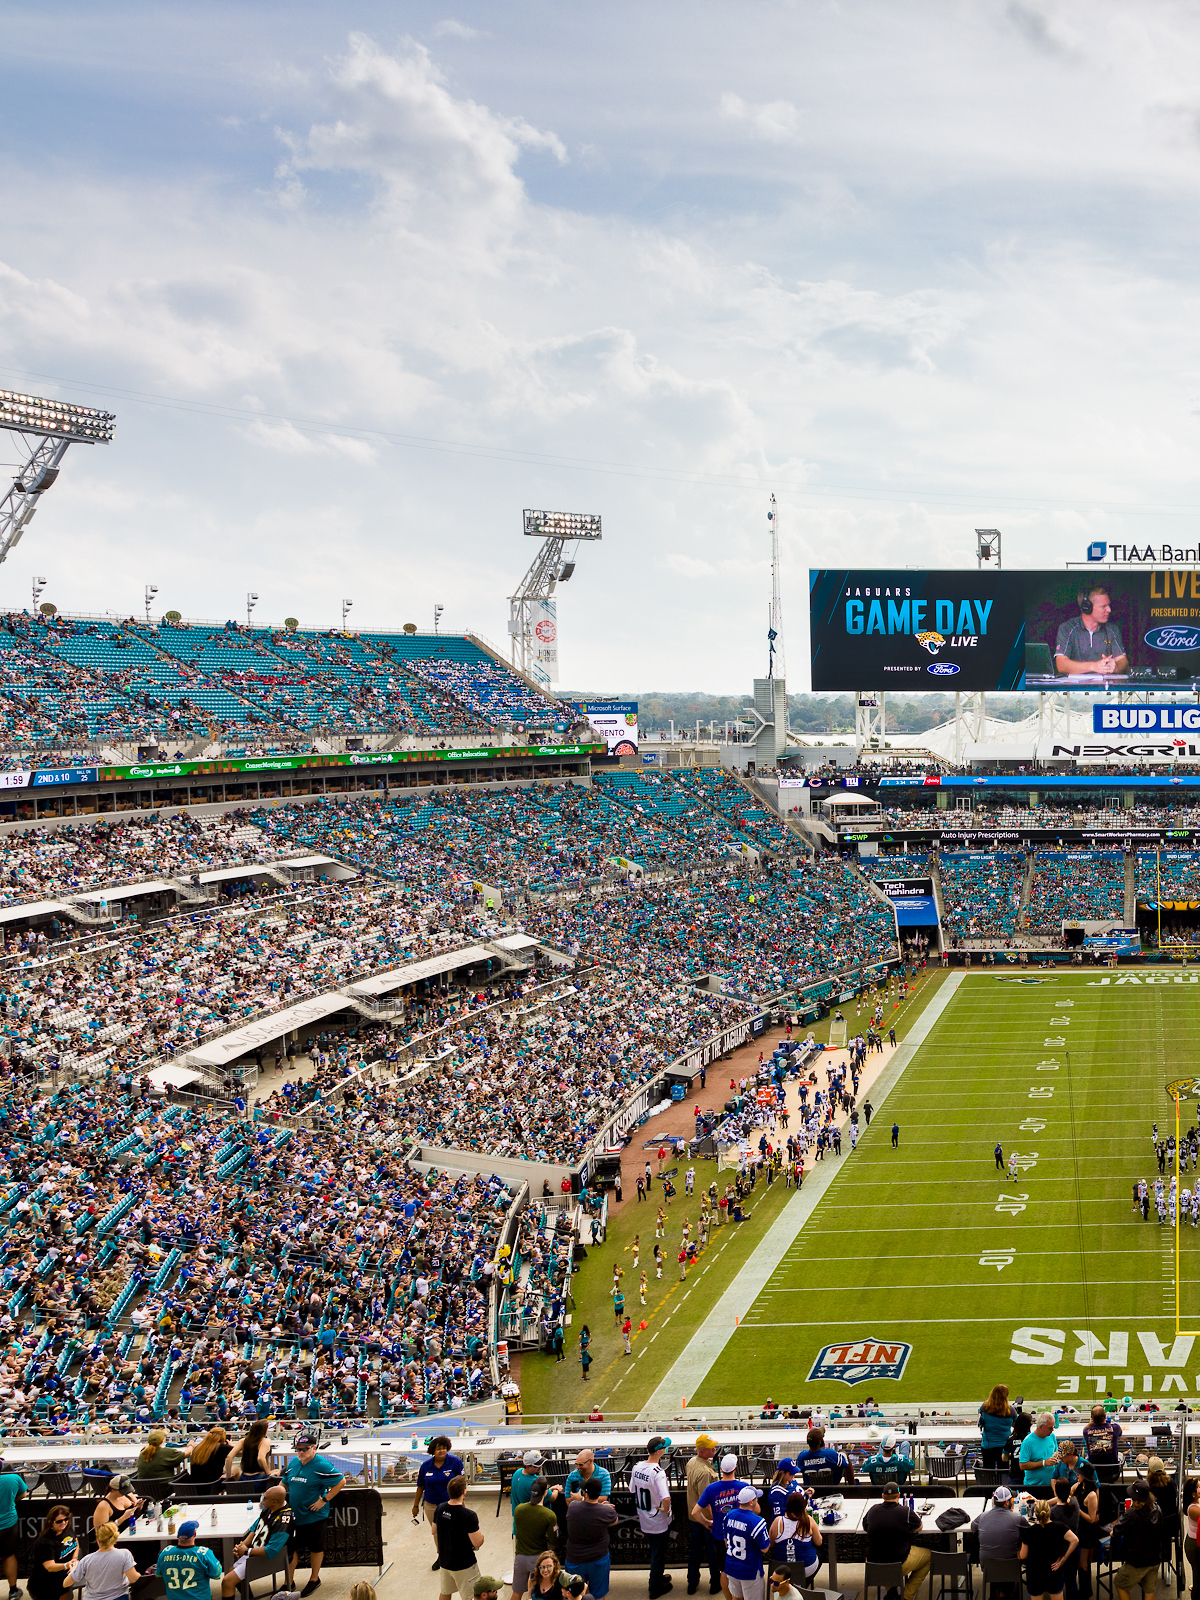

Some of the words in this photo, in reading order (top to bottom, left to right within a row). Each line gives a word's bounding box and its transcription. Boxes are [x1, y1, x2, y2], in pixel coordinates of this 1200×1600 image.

[1109, 544, 1157, 562] TIAA
[845, 587, 911, 597] JAGUARS
[845, 599, 928, 635] GAME
[935, 599, 994, 635] DAY
[1150, 608, 1189, 617] PRESENTED
[1190, 608, 1200, 617] BY:
[950, 636, 979, 647] LIVE
[1156, 628, 1199, 647] Ford
[1102, 709, 1157, 729] BUD
[600, 729, 625, 737] BENTO
[245, 761, 292, 769] ConserMoving.com
[5, 775, 24, 786] 1:59
[38, 773, 54, 784] 2ND
[54, 774, 60, 782] &
[60, 773, 70, 782] 10
[957, 831, 977, 840] Injury
[977, 831, 1019, 840] Prescriptions
[703, 1045, 711, 1066] OF
[711, 1038, 722, 1060] THE
[722, 1023, 751, 1053] JAGUARS
[1028, 1086, 1055, 1098] 50
[1018, 1117, 1048, 1130] 40
[994, 1193, 1030, 1212] 20
[978, 1247, 1017, 1266] 10
[829, 1343, 902, 1365] NFL
[804, 1457, 826, 1466] HARRISON
[634, 1470, 650, 1482] SCOBEE
[634, 1484, 652, 1512] 10
[719, 1489, 735, 1498] FEAR
[281, 1515, 290, 1524] 93
[727, 1518, 748, 1532] MANNING
[726, 1532, 747, 1561] 18
[163, 1554, 198, 1563] JONES-DREW
[165, 1567, 198, 1590] 32
